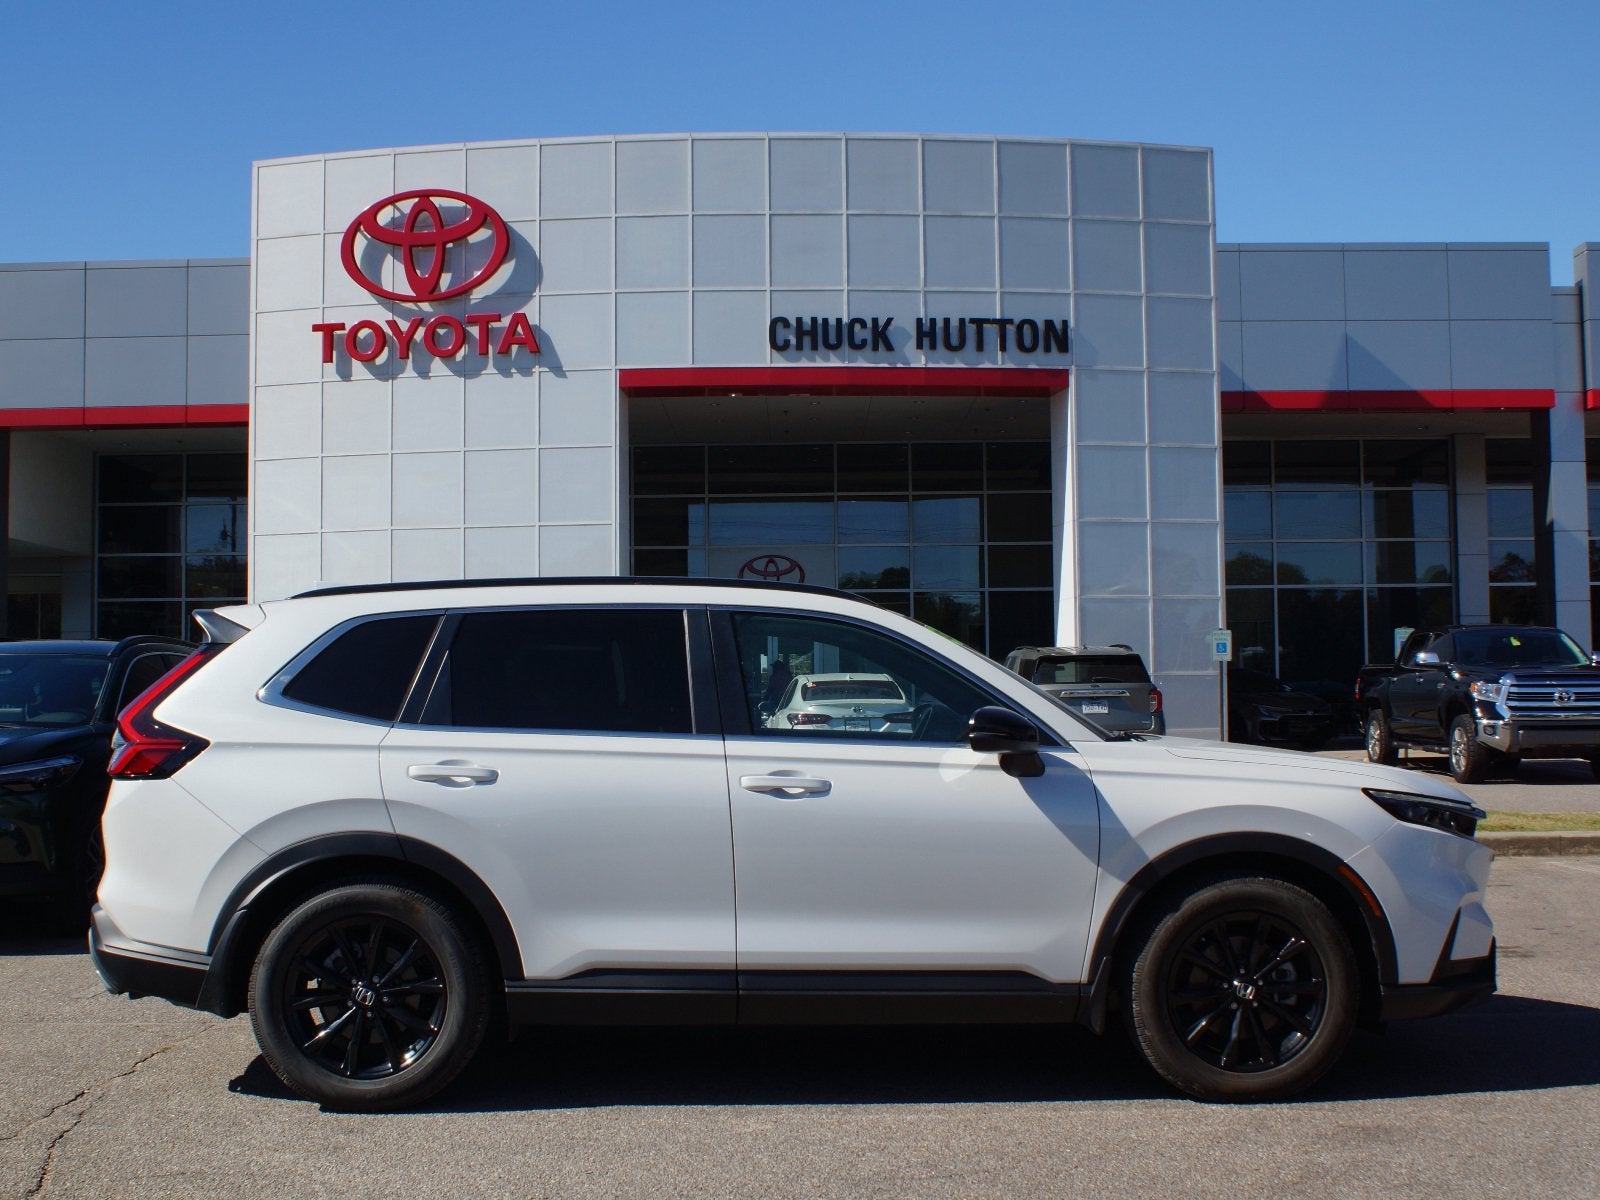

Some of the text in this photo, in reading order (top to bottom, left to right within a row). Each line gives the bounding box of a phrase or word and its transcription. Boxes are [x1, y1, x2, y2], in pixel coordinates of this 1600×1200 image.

[312, 312, 541, 363] TOYOTA
[769, 316, 1070, 354] CHUCK HUTTON
